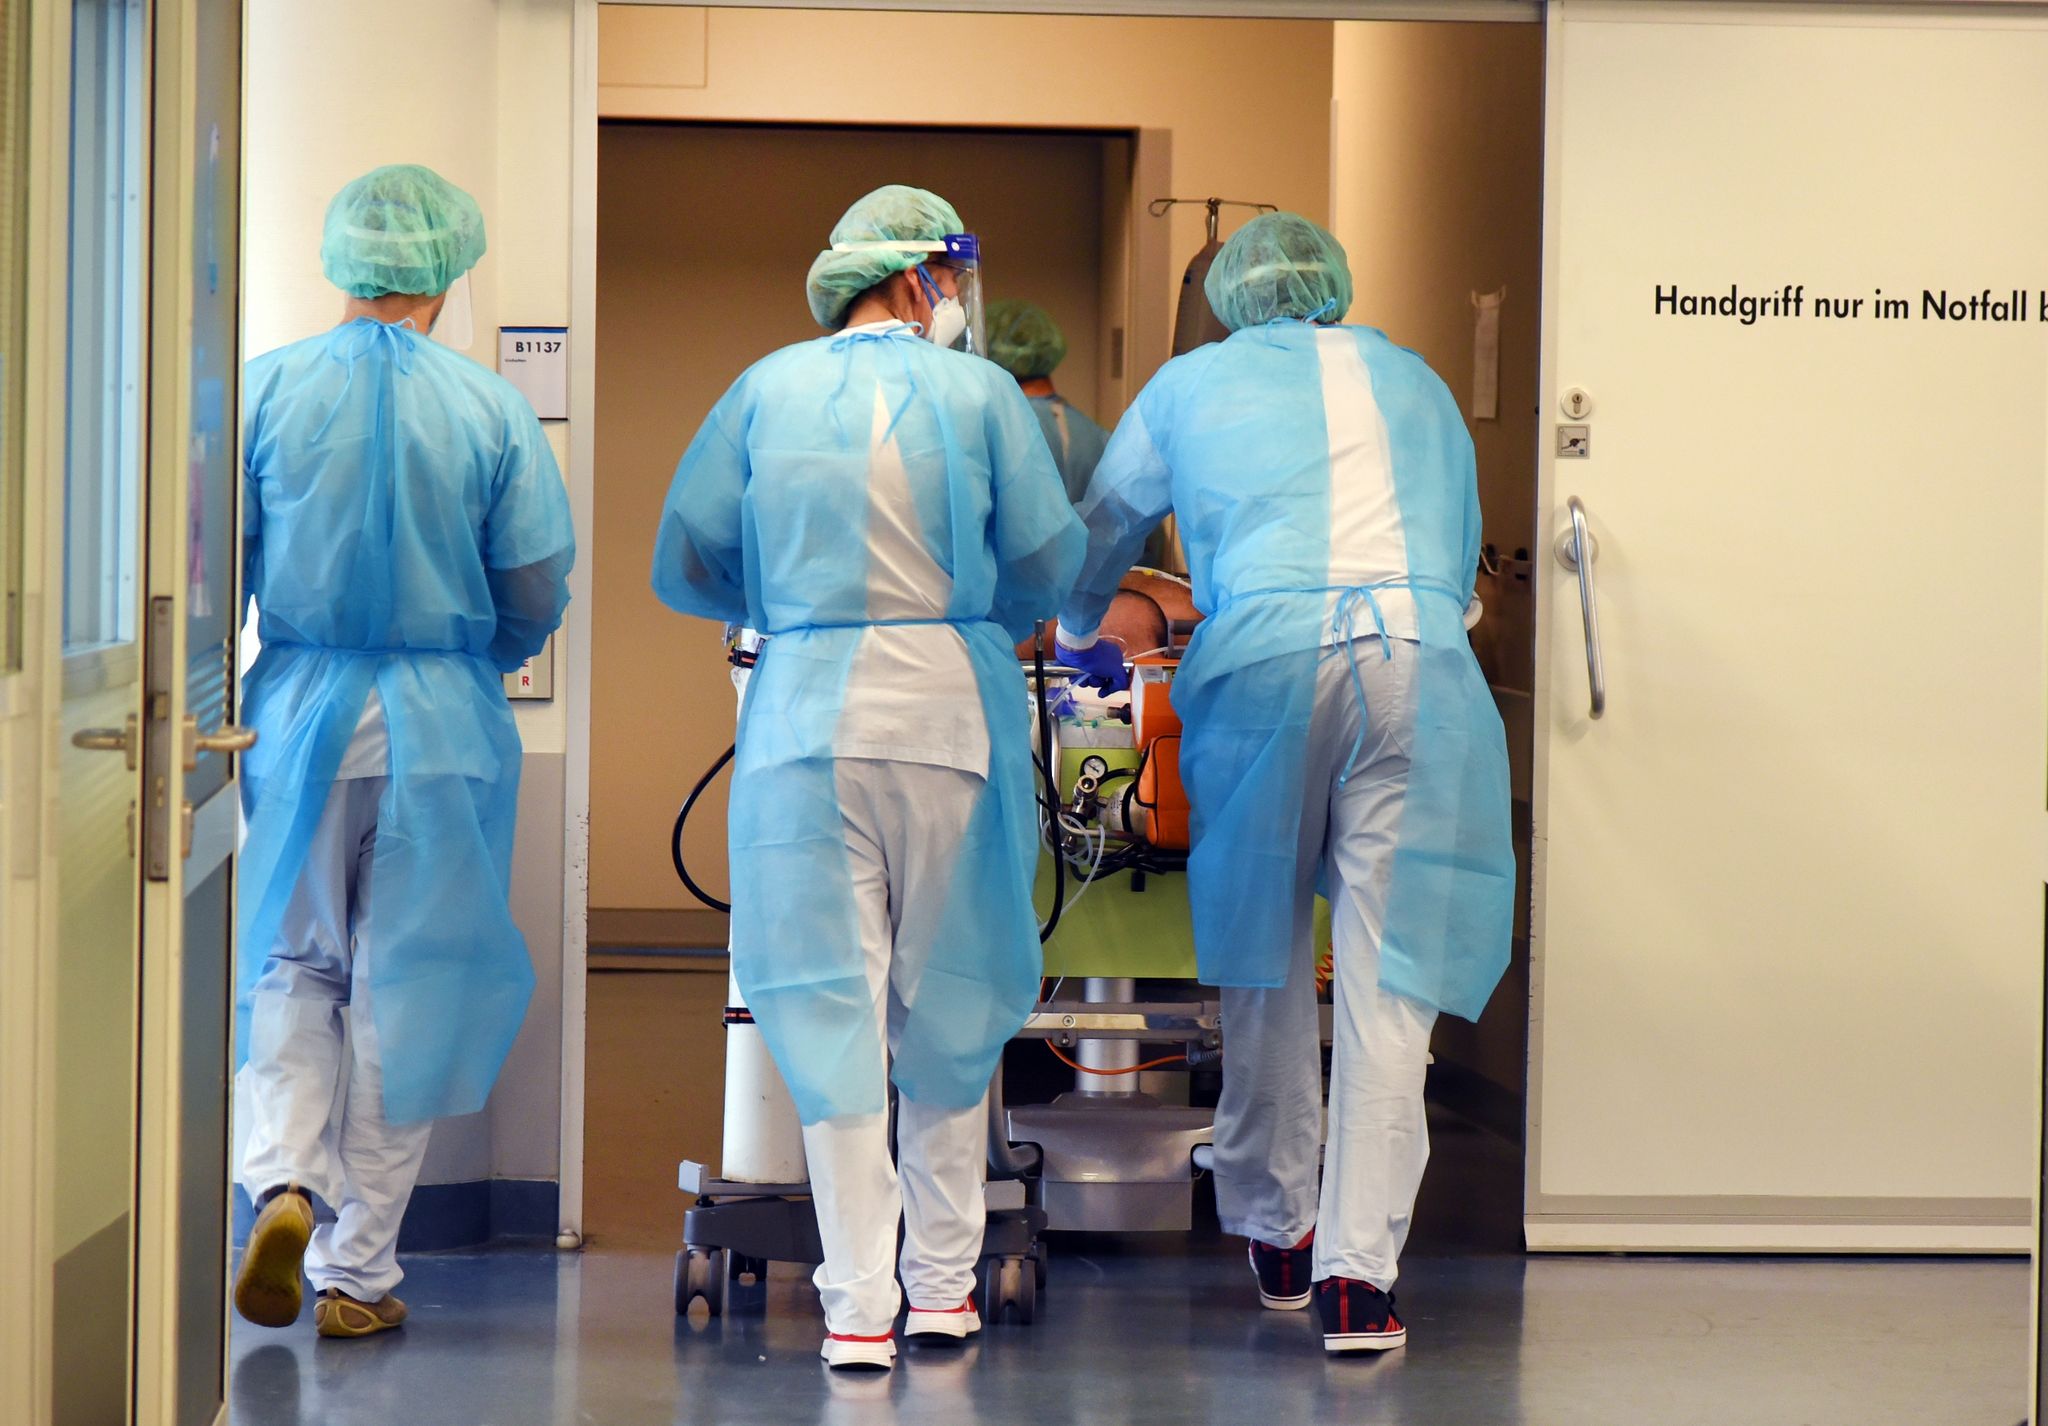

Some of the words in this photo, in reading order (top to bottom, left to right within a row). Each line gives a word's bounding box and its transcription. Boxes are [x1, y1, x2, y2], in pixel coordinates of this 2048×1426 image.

[1655, 284, 1804, 326] Handgriff
[1814, 297, 1864, 319] nur
[1874, 288, 1909, 320] im
[1922, 289, 2027, 322] Notfall
[515, 341, 562, 353] B1137
